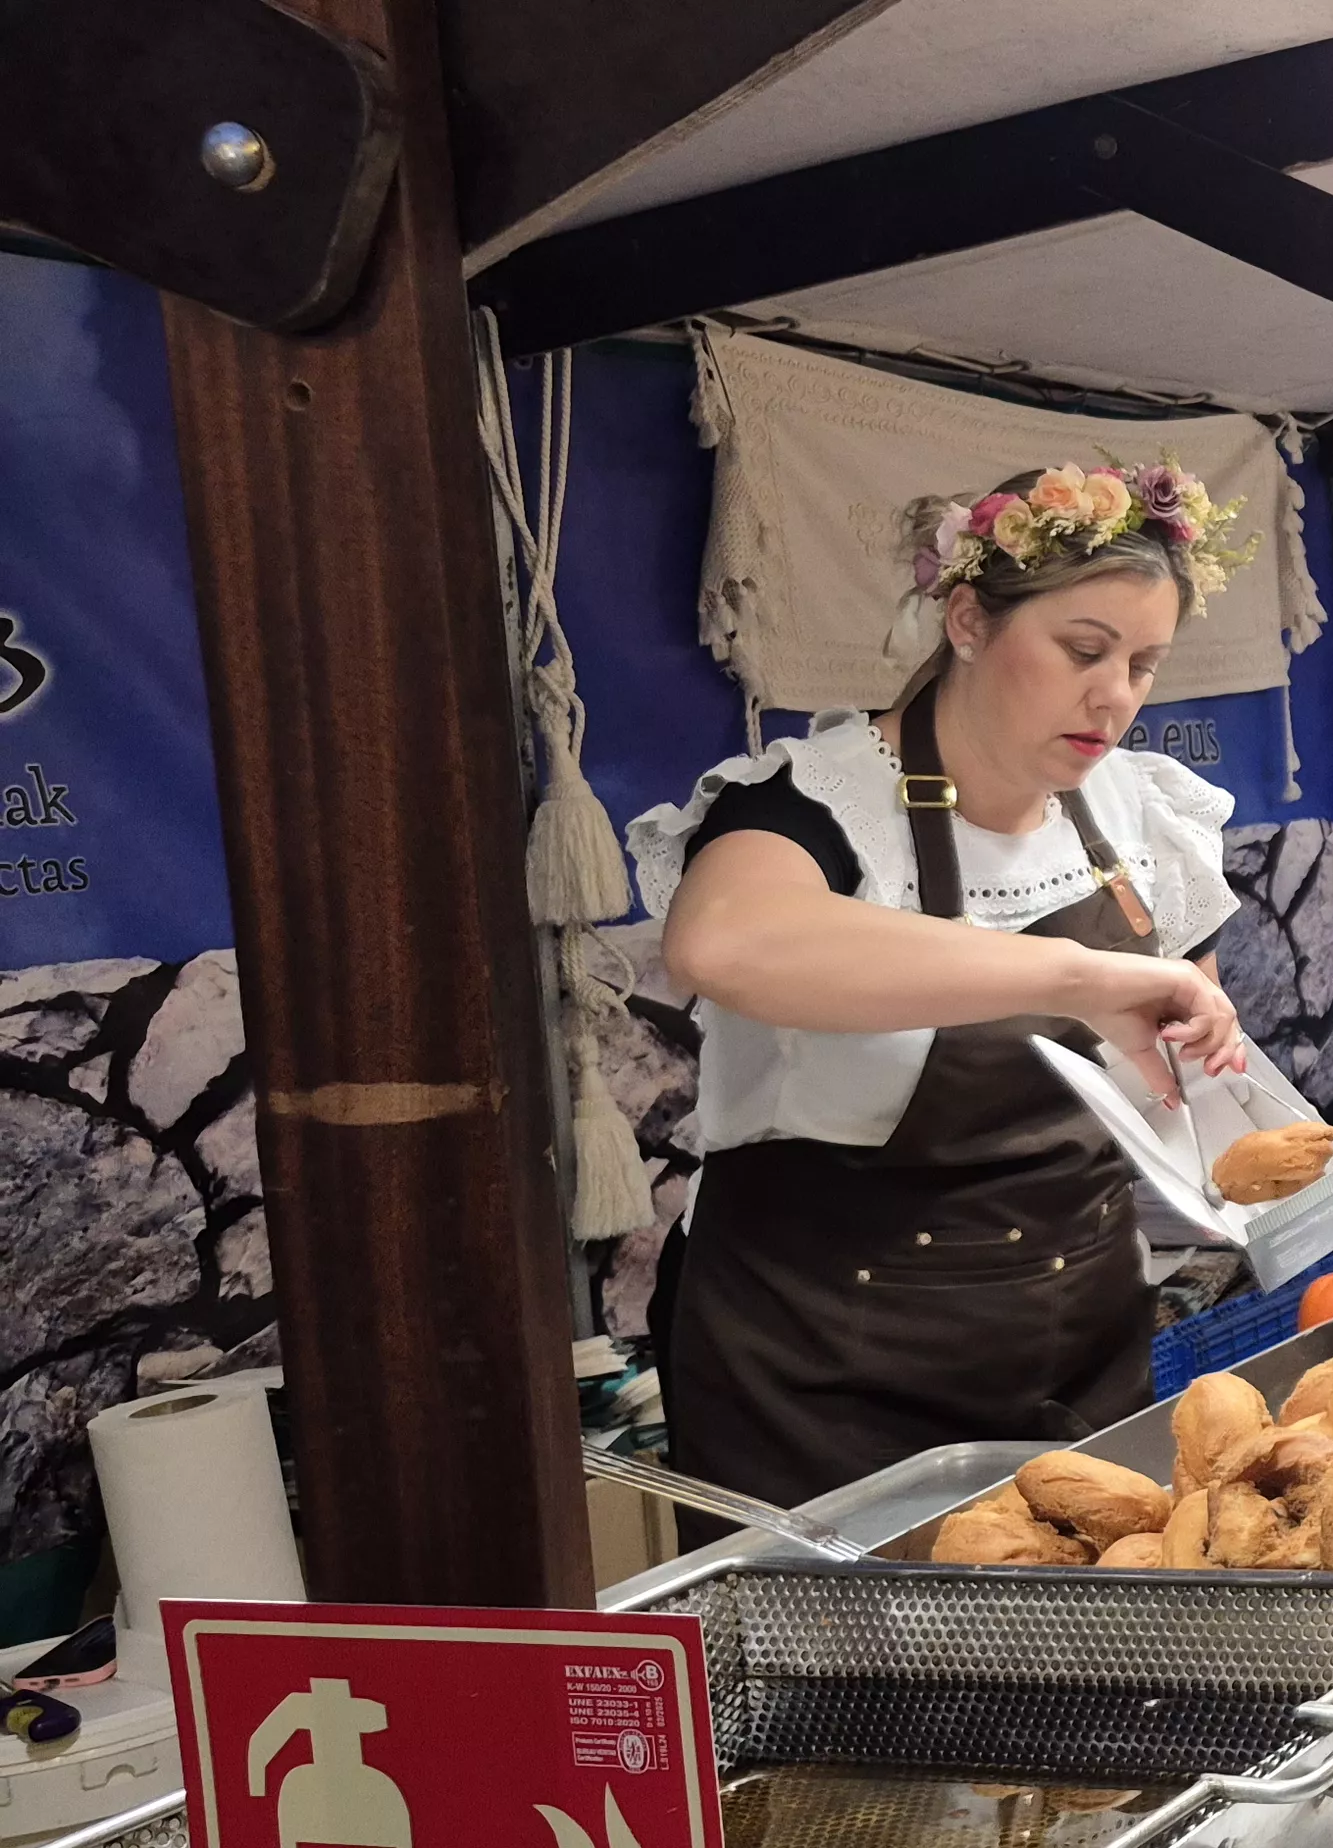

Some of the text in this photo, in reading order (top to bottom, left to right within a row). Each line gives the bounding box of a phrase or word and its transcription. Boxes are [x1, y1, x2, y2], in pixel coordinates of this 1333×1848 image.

[0, 765, 77, 827] ak
[645, 1664, 659, 1679] B
[568, 1698, 639, 1709] UNE 23033-1
[569, 1707, 640, 1718] UNE 23035-4
[570, 1716, 641, 1727] ISO 7010:2020
